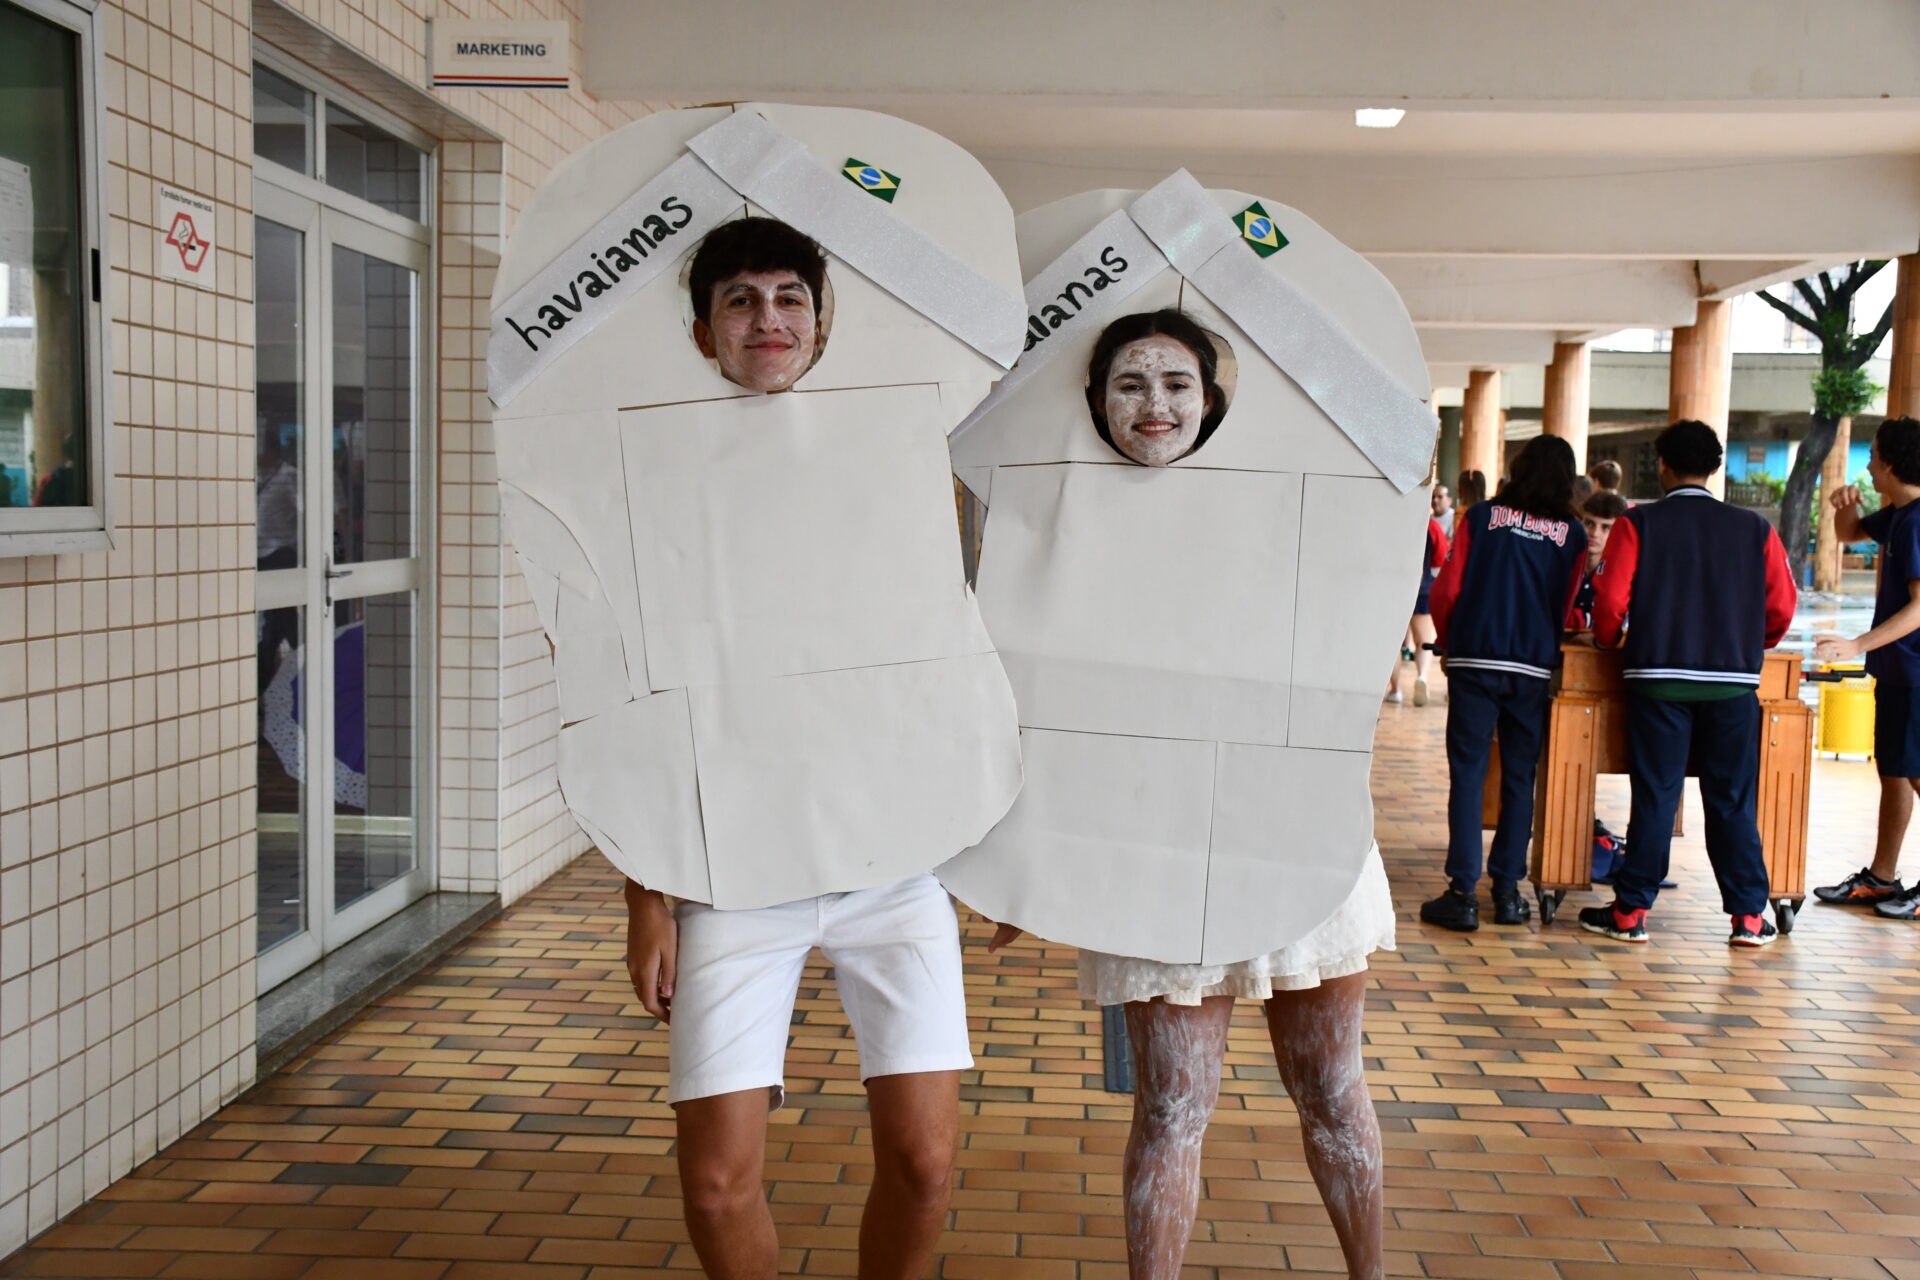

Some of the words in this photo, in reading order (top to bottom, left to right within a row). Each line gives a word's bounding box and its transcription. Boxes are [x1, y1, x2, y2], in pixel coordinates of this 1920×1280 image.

[456, 42, 546, 57] MARKETING
[505, 196, 693, 352] havaianas
[1488, 505, 1523, 530] DOM
[1523, 512, 1569, 547] BOSCO
